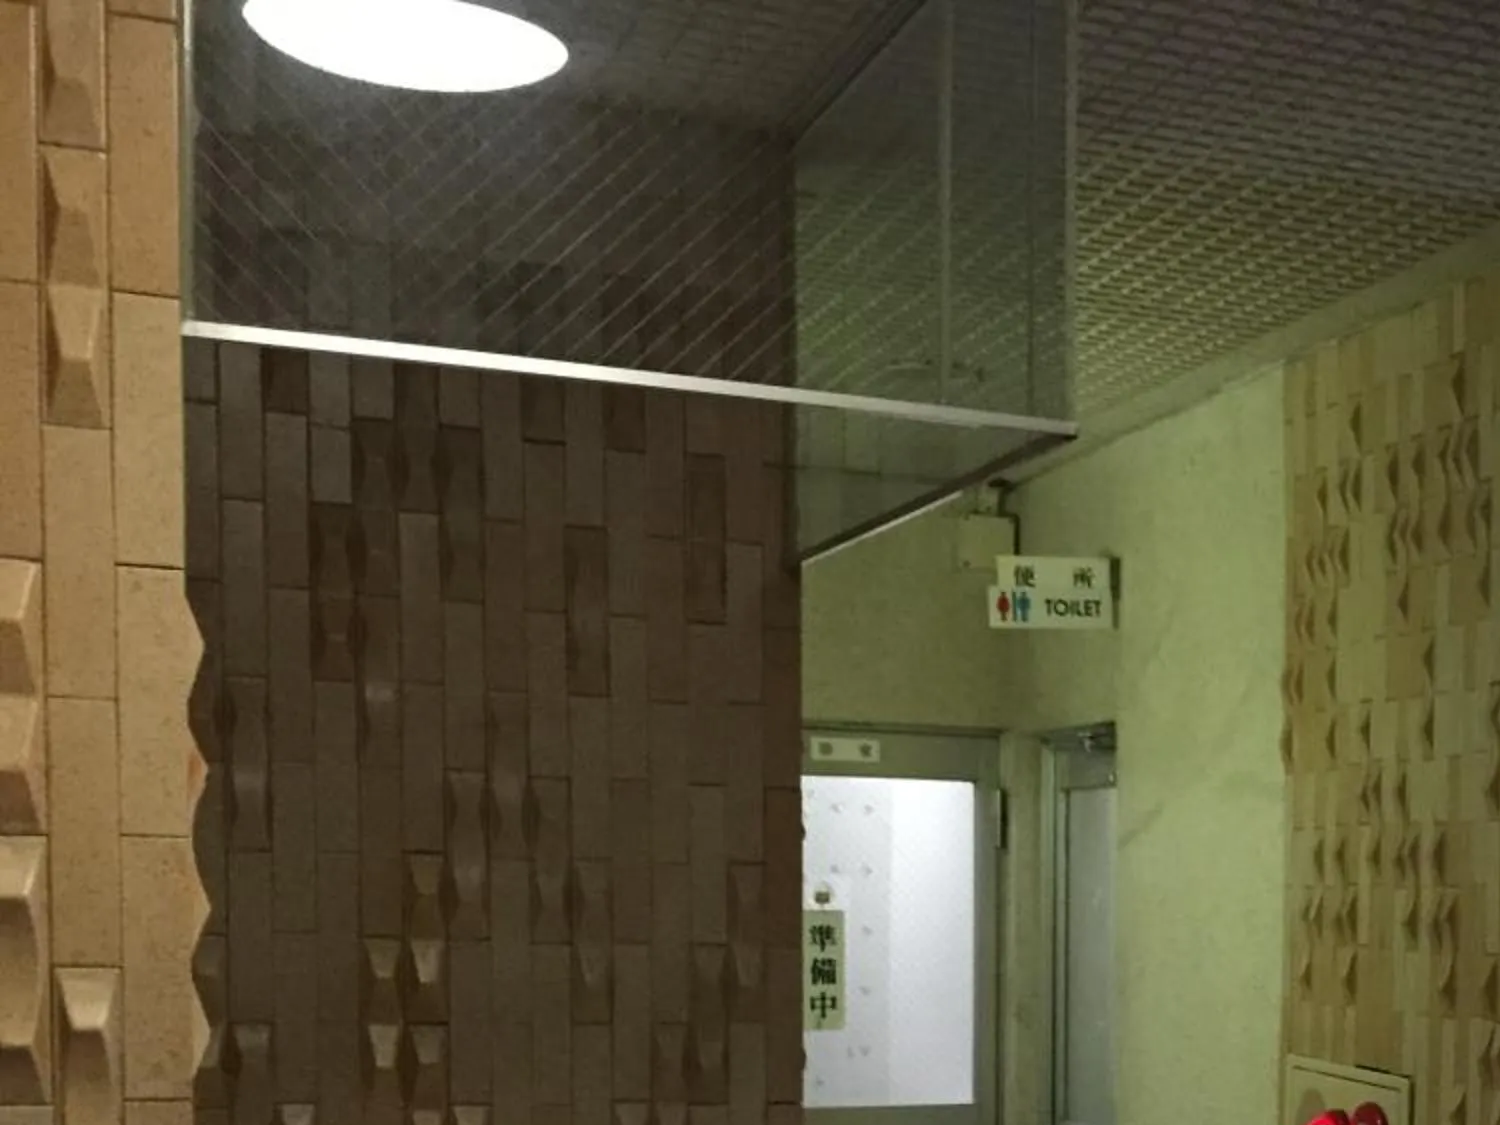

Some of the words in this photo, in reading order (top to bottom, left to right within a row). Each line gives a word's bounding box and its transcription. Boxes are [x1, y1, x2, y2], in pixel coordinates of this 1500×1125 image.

[1045, 598, 1101, 617] TOILET
[809, 923, 838, 1019] 準備中
